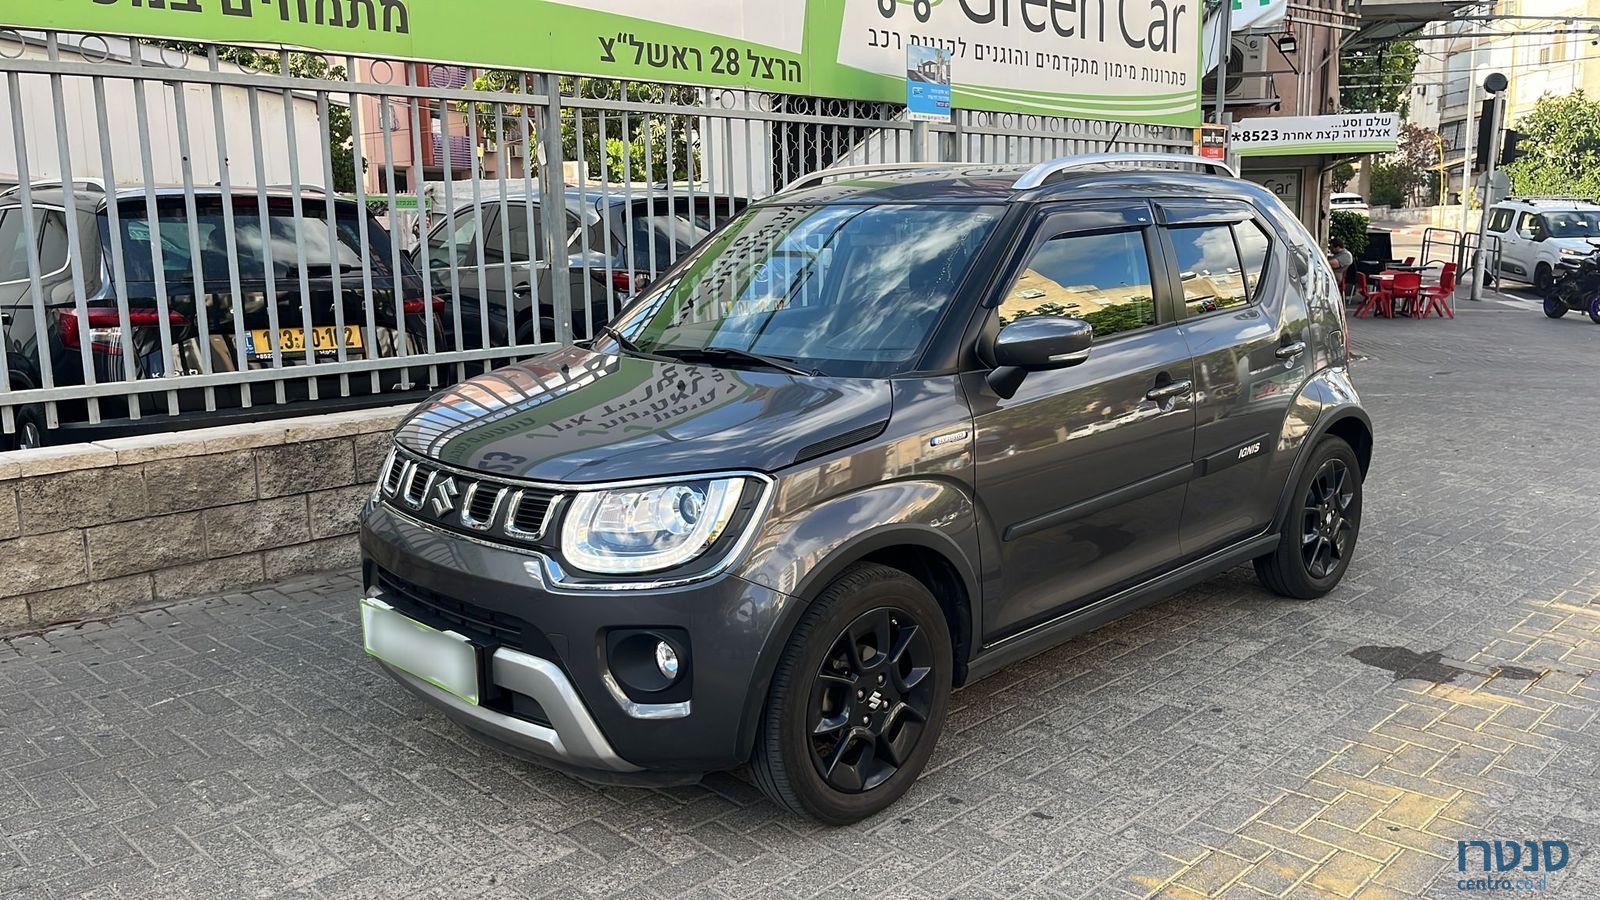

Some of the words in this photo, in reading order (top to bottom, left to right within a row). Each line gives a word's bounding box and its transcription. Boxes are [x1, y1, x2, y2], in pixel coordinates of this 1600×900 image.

[222, 0, 409, 34] מתמחם
[1118, 0, 1186, 54] Car
[868, 28, 901, 49] רכב
[710, 45, 740, 76] 28
[974, 43, 1029, 67] והוגנים
[1036, 52, 1099, 77] מתקדמים
[747, 48, 802, 83] הרצל
[1104, 61, 1137, 81] מימון
[1141, 66, 1187, 86] פתרונות
[1365, 116, 1392, 127] שלם
[1282, 132, 1313, 141] אחרת
[1315, 129, 1339, 142] קצת
[1343, 129, 1355, 139] זה
[1359, 127, 1391, 138] אצלנו
[1238, 442, 1261, 459] IGNIS
